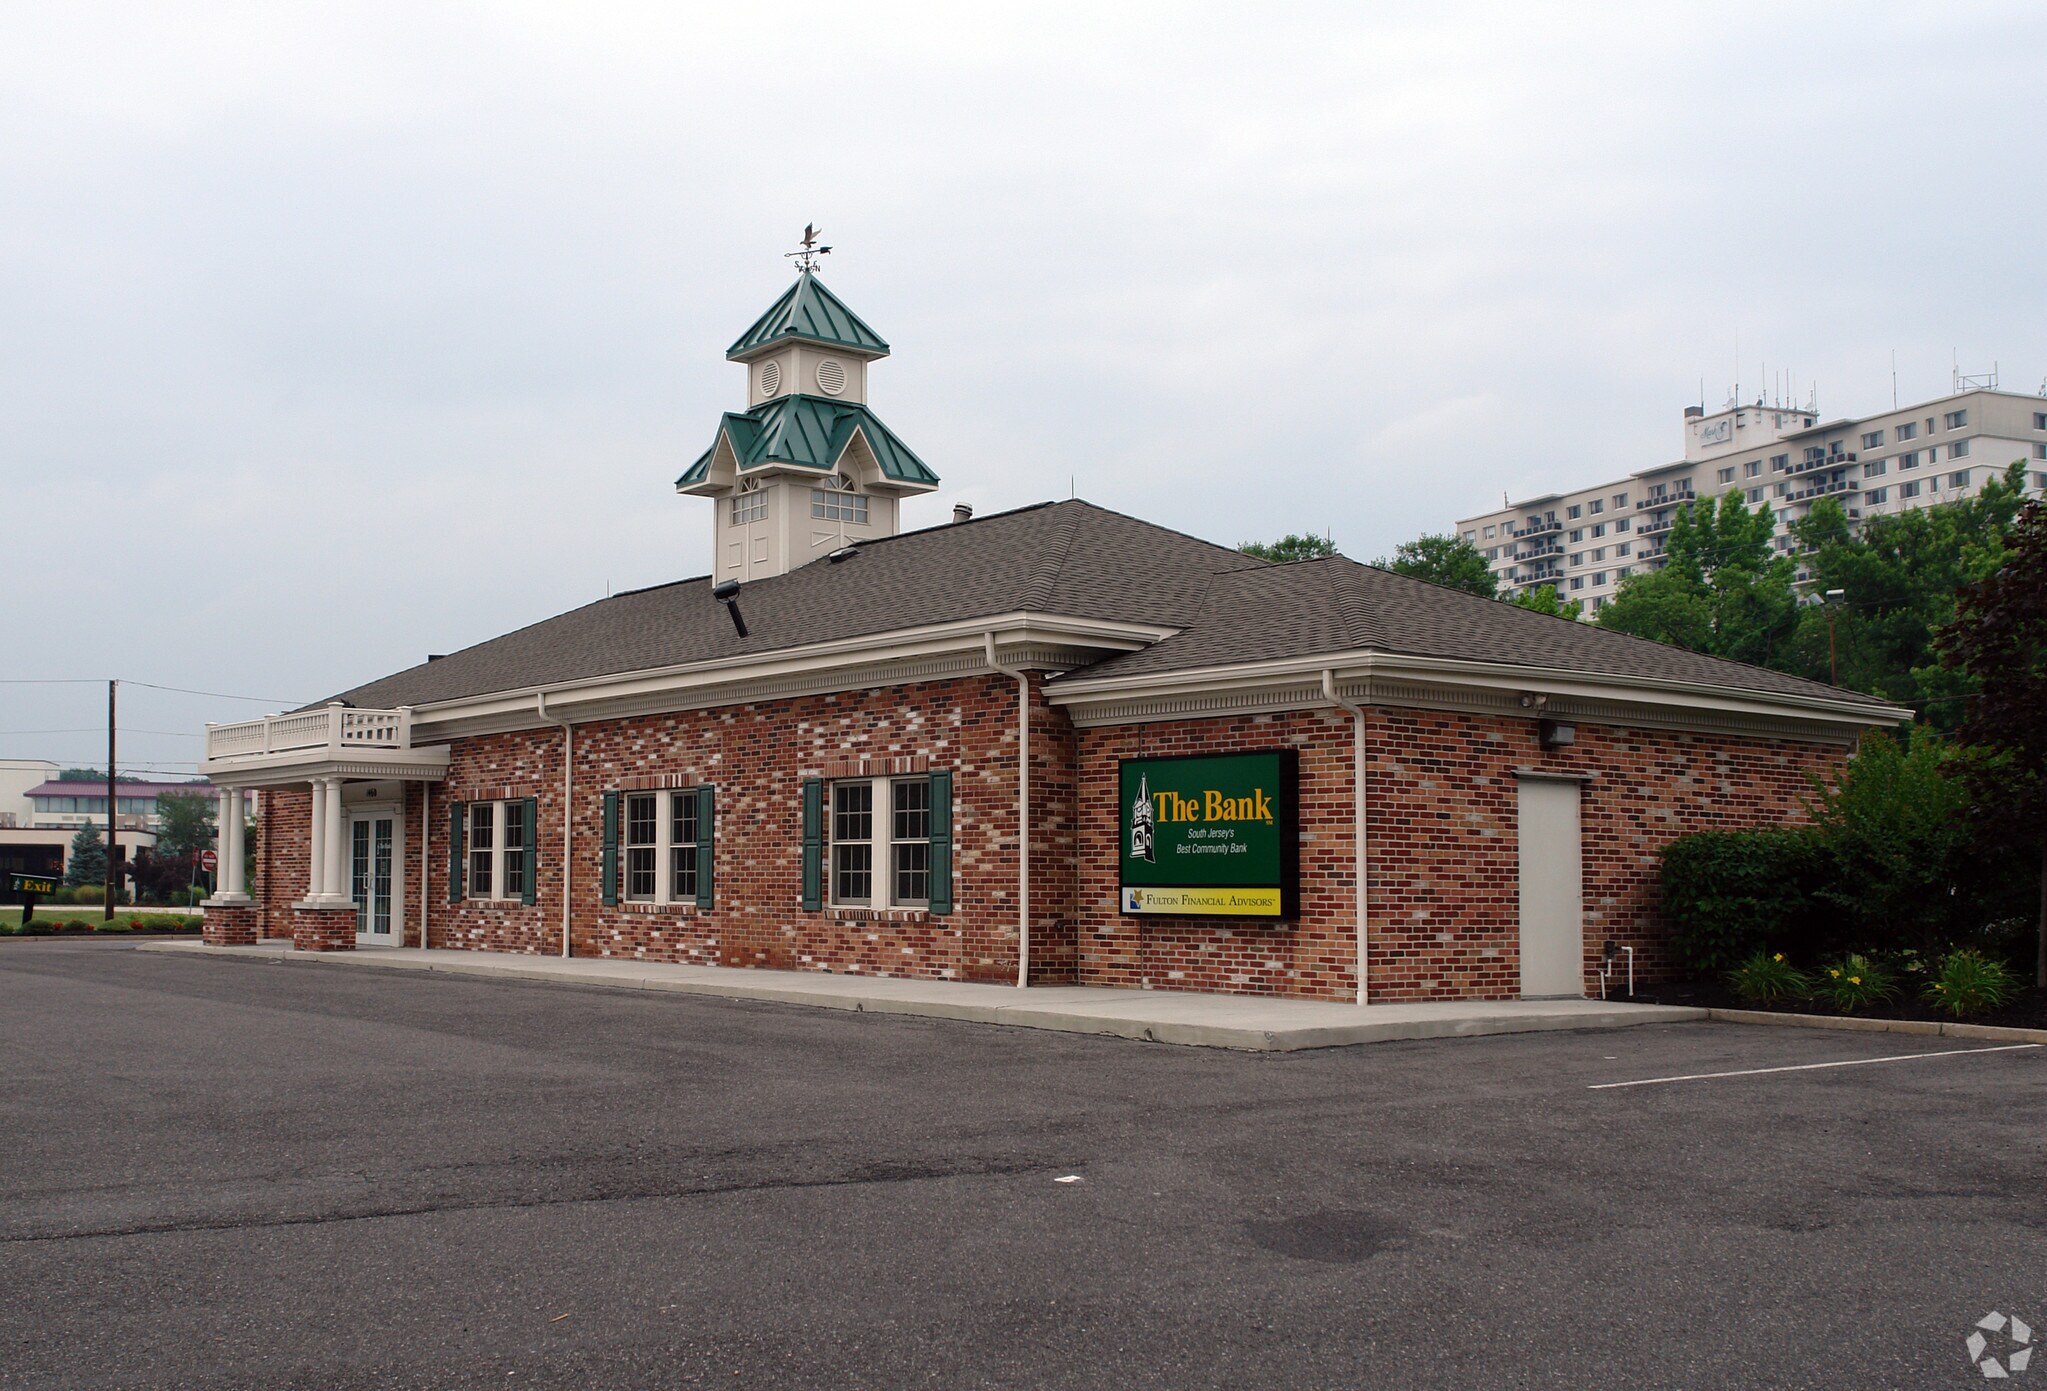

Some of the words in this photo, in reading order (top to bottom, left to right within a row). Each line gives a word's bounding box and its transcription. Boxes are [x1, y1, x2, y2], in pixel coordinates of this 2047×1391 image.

[1153, 791, 1200, 822] The
[1203, 788, 1273, 821] Bank
[1188, 828, 1206, 838] South
[1208, 828, 1234, 839] Jersey's
[1177, 844, 1190, 853] Best
[1192, 843, 1229, 855] Community
[1230, 842, 1248, 853] Bank
[23, 880, 51, 892] Exit
